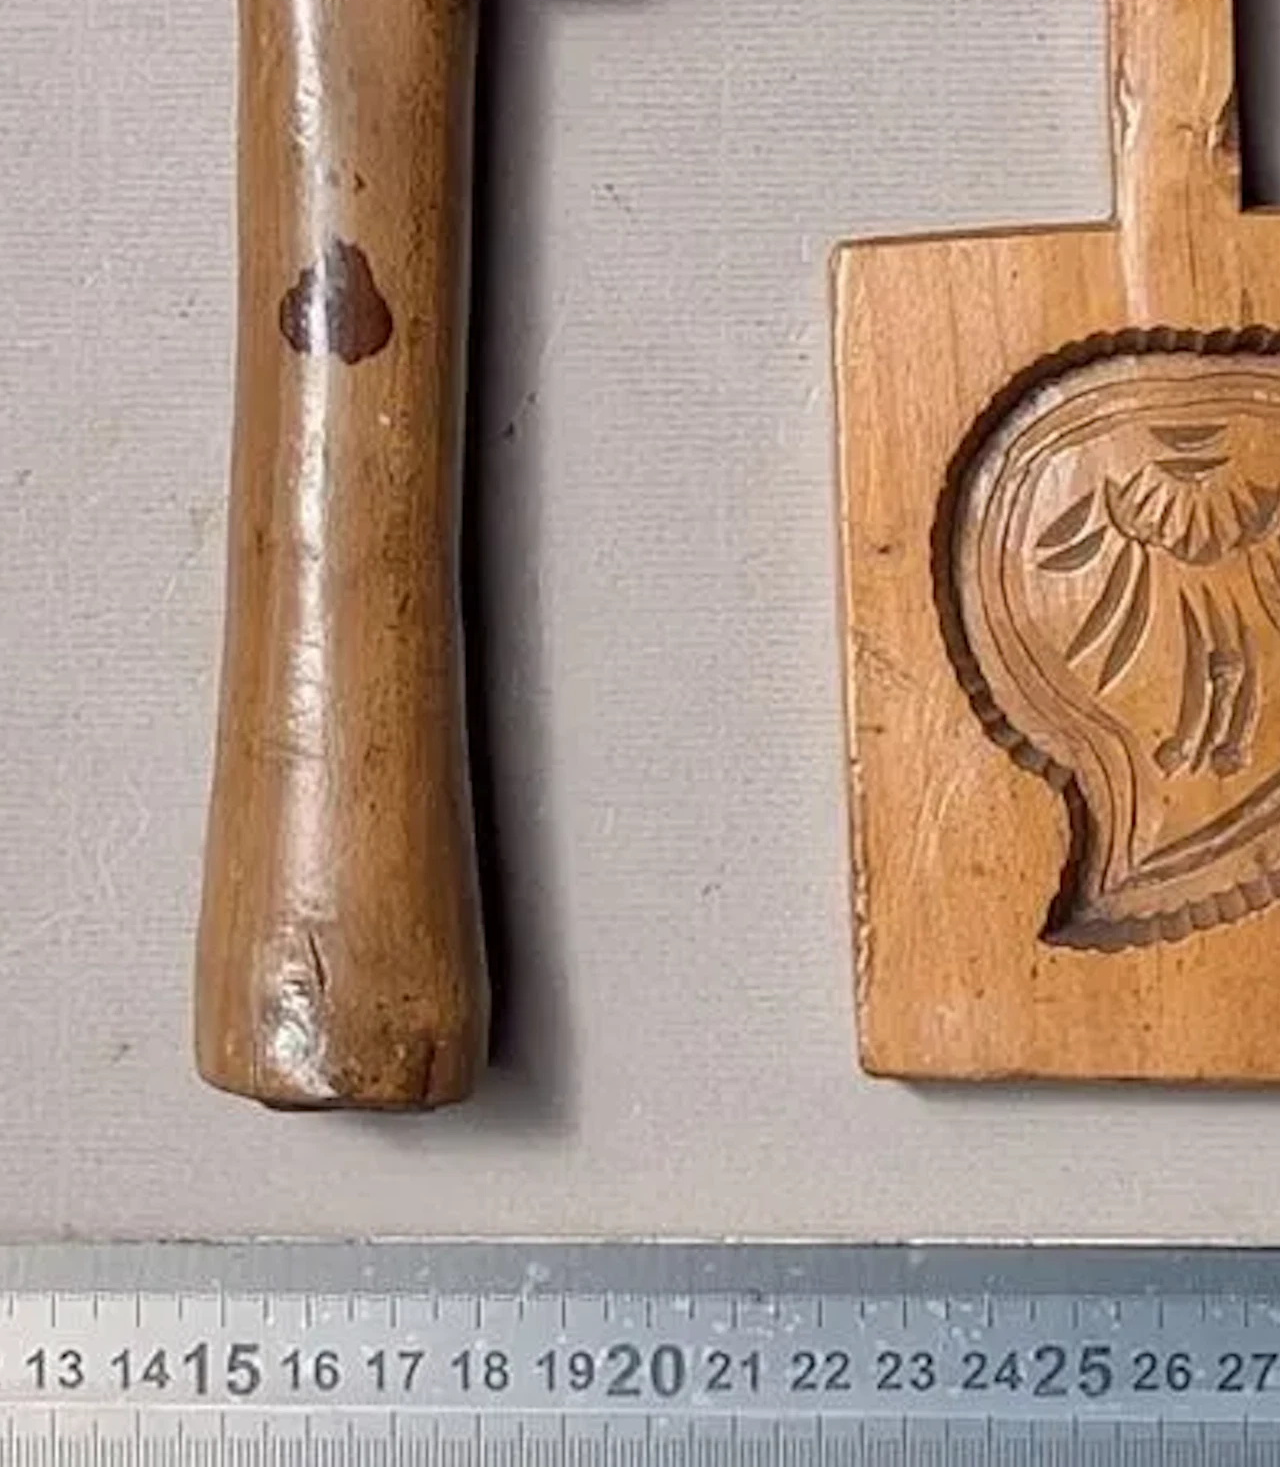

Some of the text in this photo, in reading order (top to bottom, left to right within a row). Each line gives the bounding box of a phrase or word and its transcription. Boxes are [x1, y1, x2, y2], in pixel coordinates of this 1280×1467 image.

[27, 1348, 83, 1391] 13
[112, 1349, 170, 1391] 14
[184, 1341, 260, 1396] 15
[281, 1349, 339, 1392] 16
[368, 1350, 424, 1392] 17
[452, 1350, 508, 1392] 18
[537, 1350, 594, 1392] 19
[607, 1344, 685, 1398] 20
[706, 1350, 758, 1392] 21
[792, 1351, 850, 1391] 22
[878, 1351, 935, 1392] 23
[963, 1350, 1023, 1391] 24
[1034, 1345, 1112, 1398] 25
[1134, 1352, 1193, 1392] 26
[1217, 1353, 1277, 1392] 27
